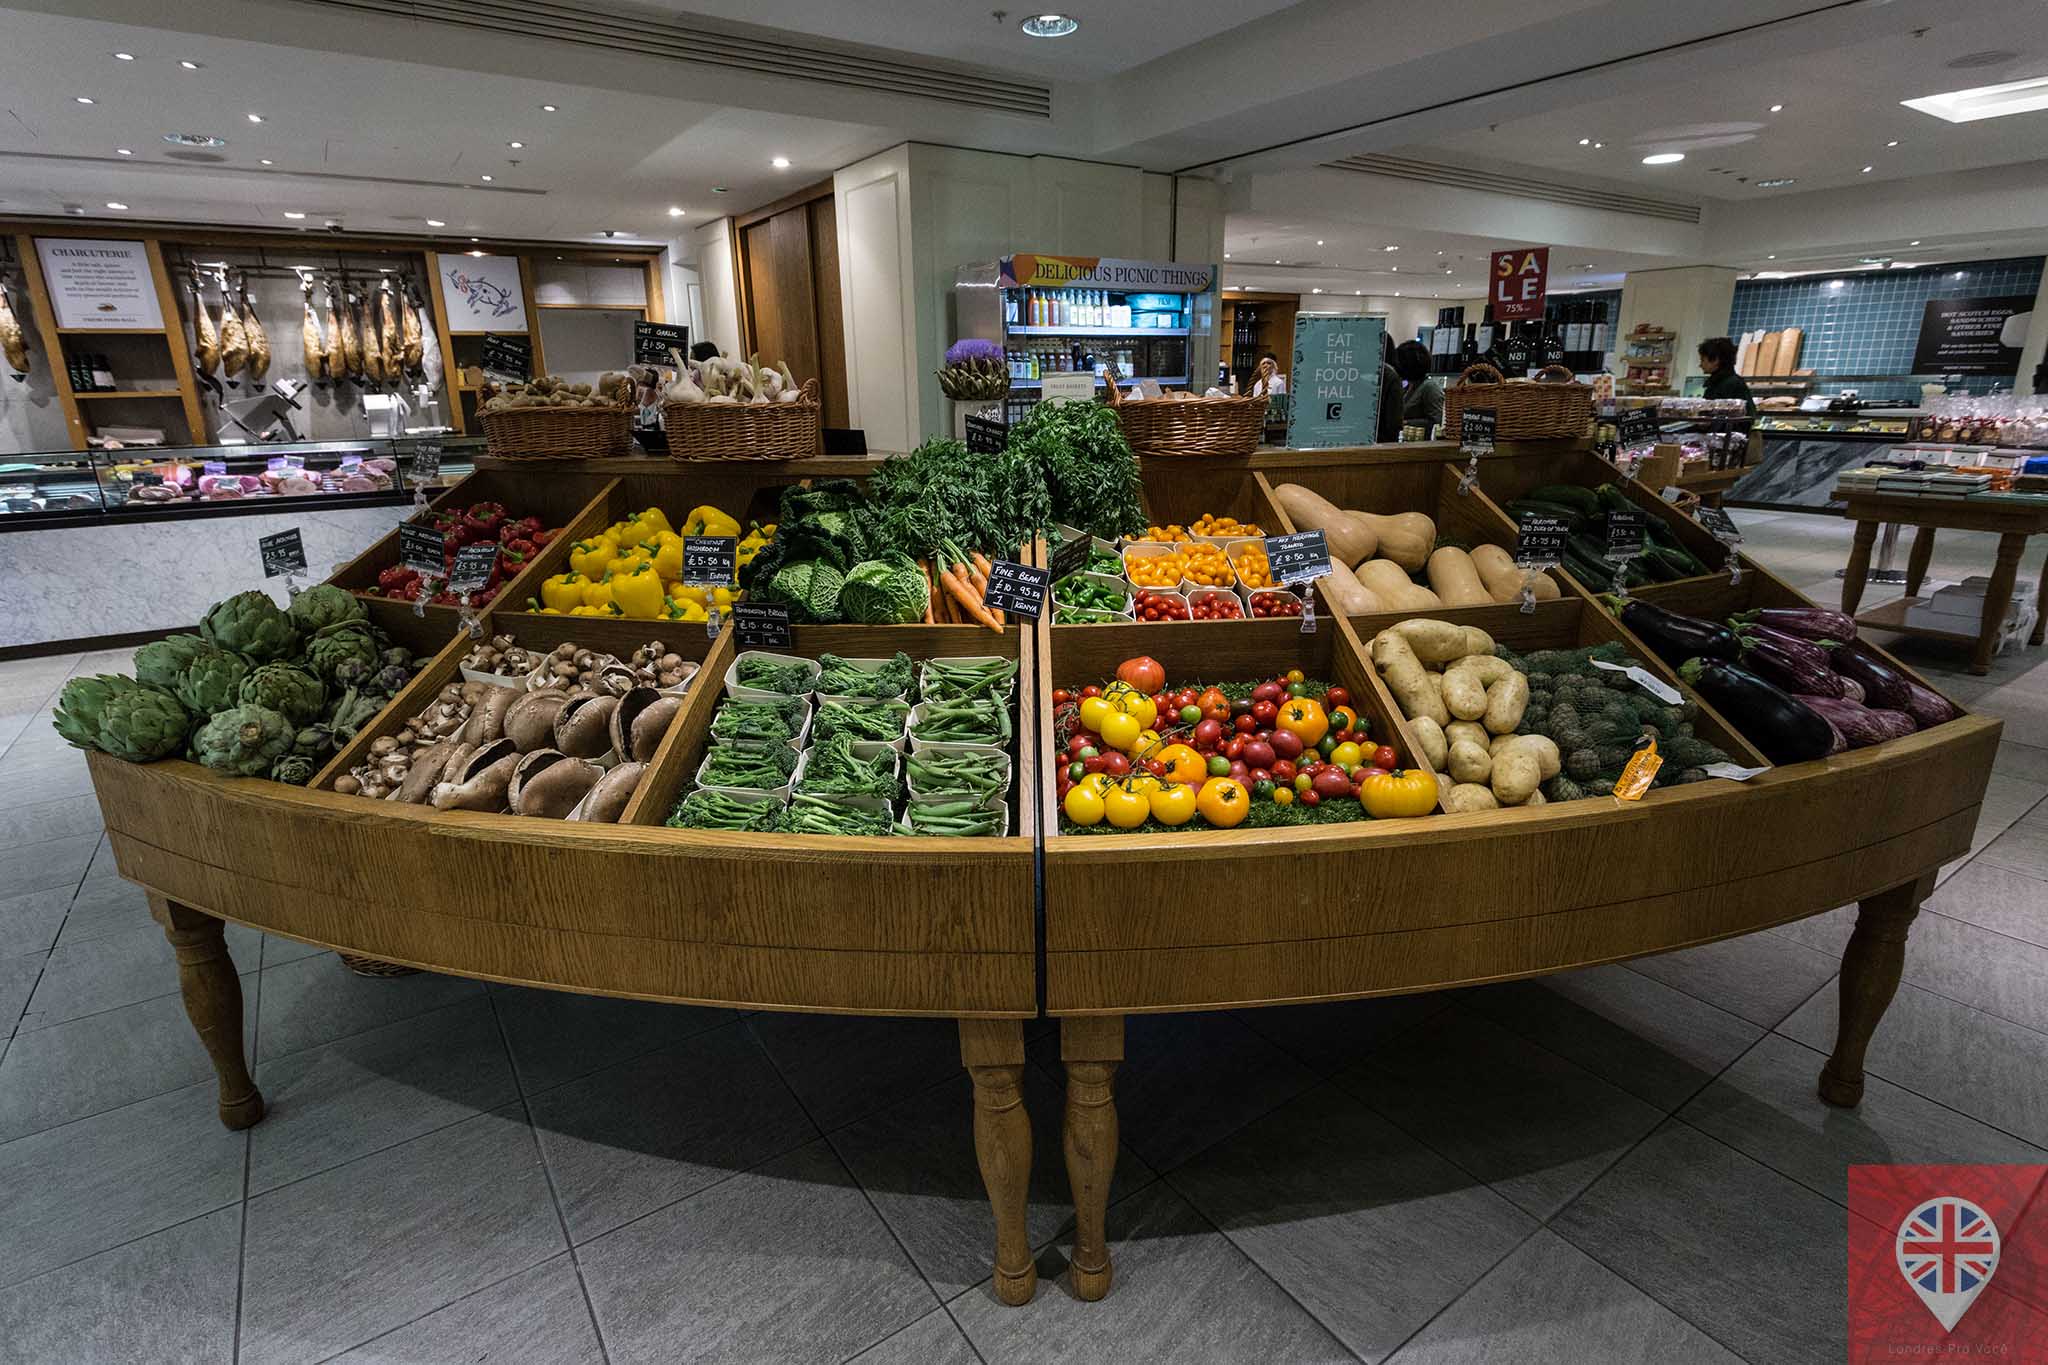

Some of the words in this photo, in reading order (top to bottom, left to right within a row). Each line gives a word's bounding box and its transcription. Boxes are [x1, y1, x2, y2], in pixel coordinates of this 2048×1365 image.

[52, 248, 133, 258] CHARCUTERIE
[1036, 263, 1111, 282] DELICIOUS
[1115, 268, 1159, 283] PICNIC
[1162, 269, 1209, 286] THINGS
[1505, 304, 1523, 312] 75%
[656, 329, 679, 338] GARLIC
[1327, 333, 1354, 347] EAT
[1326, 351, 1353, 364] THE
[1315, 368, 1359, 382] FOOD
[1317, 386, 1354, 399] HALL
[1522, 536, 1549, 546] £3.75
[686, 544, 720, 552] MUSHROOM
[687, 554, 718, 566] £5.50
[1275, 553, 1304, 565] £8.50
[994, 566, 1014, 578] FINE
[1018, 571, 1041, 584] BEAN
[993, 579, 1031, 596] £10.95
[993, 595, 1003, 606] 1
[1014, 600, 1037, 614] KENYA
